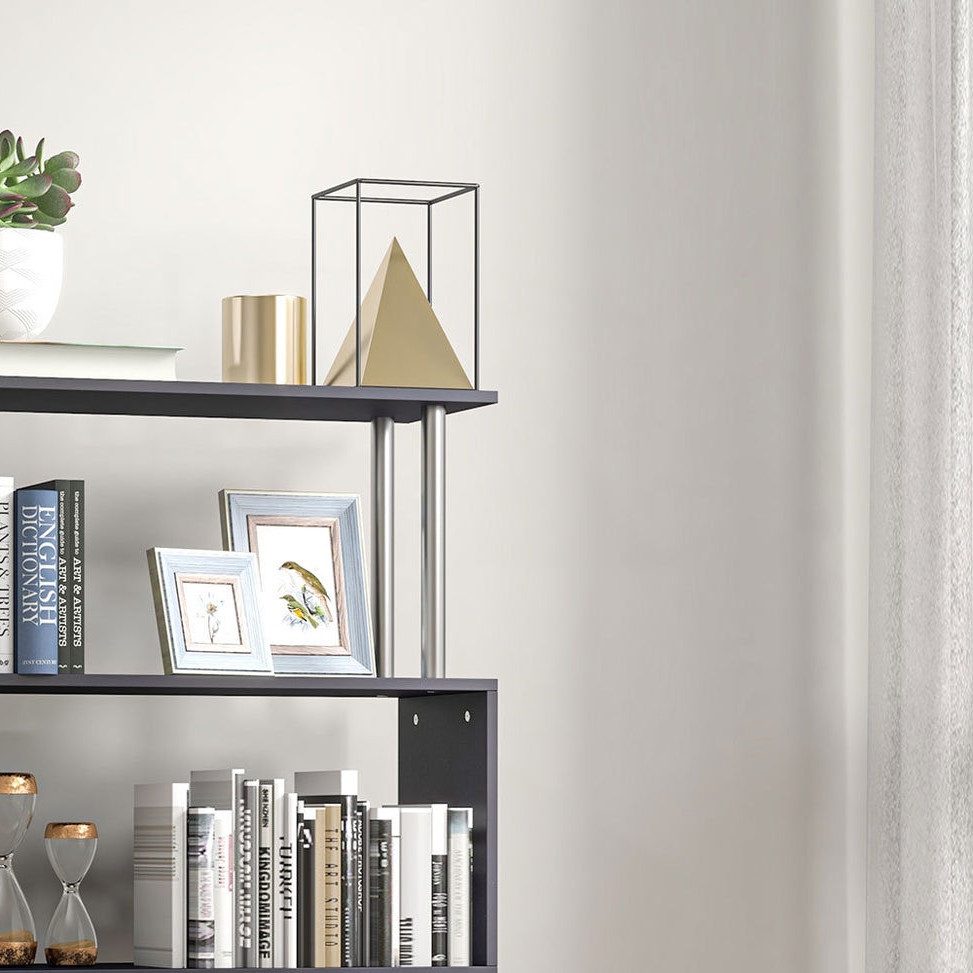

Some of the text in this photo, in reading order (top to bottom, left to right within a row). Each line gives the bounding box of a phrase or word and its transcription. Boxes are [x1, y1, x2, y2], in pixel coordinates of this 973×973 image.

[21, 505, 38, 626] DICTIONARY
[39, 505, 57, 626] ENGLISH
[58, 557, 66, 582] ART
[73, 557, 81, 582] ART
[58, 584, 66, 594] &
[73, 584, 81, 594] &
[58, 596, 66, 647] ARTISTS
[73, 596, 81, 647] ARTISTS
